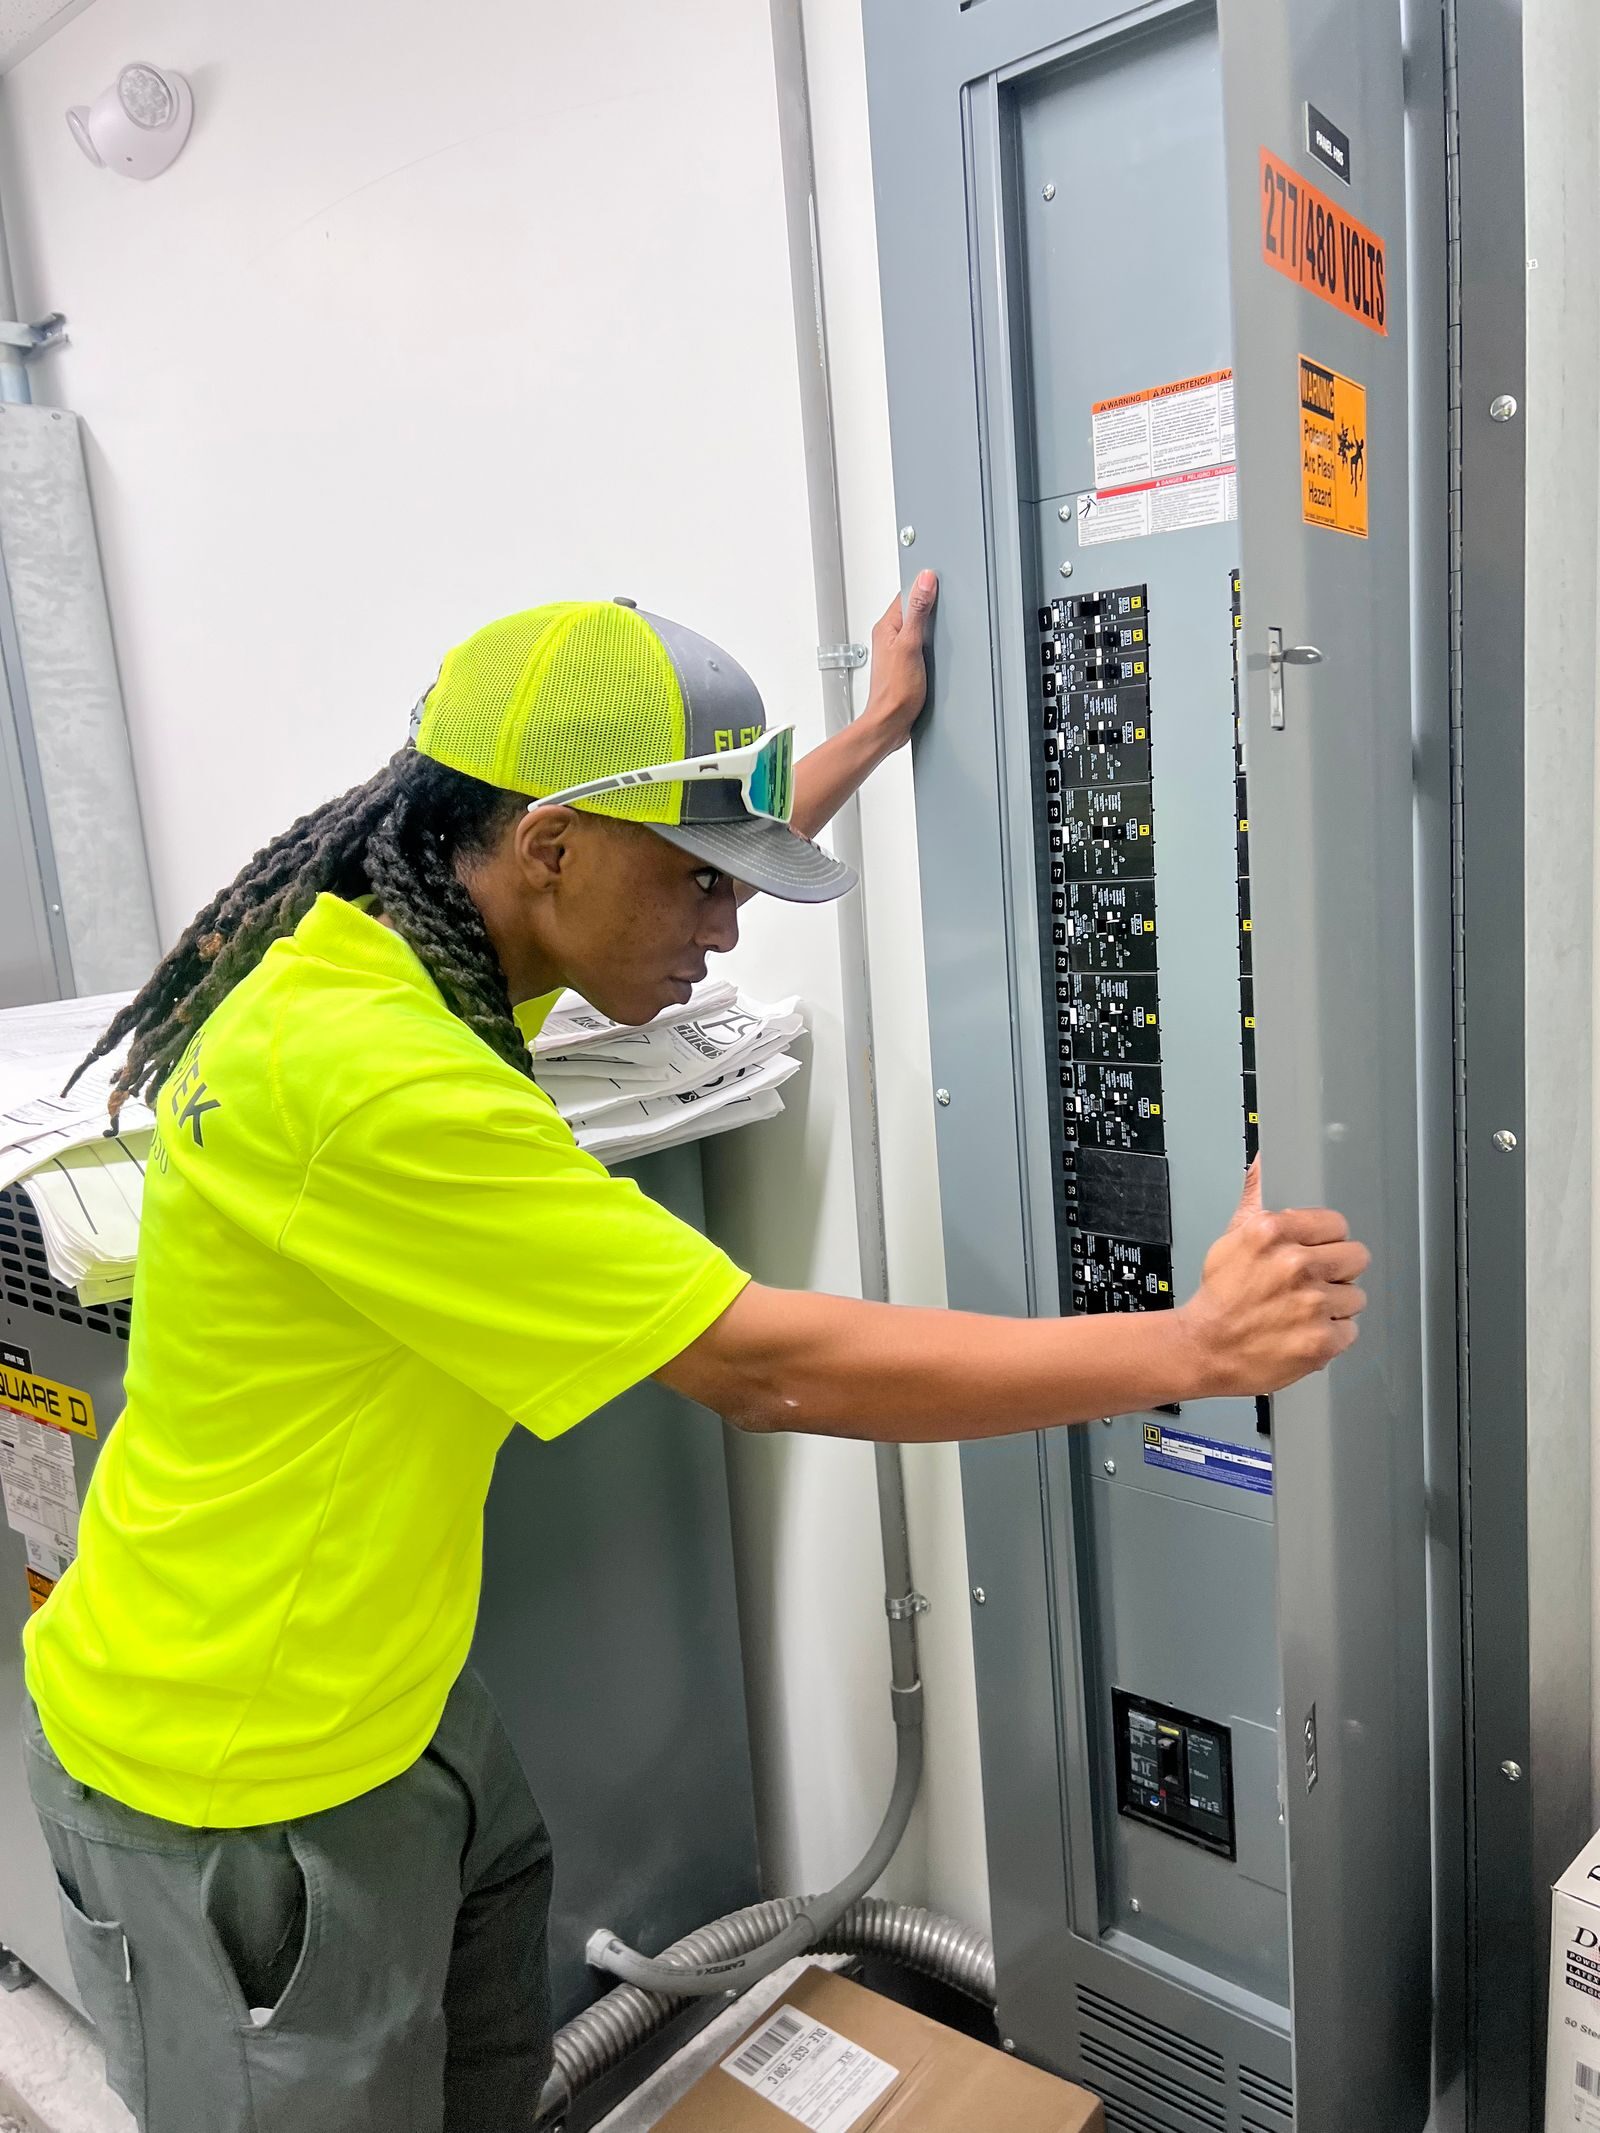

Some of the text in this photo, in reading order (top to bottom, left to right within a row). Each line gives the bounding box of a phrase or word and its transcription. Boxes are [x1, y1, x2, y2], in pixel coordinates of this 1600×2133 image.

[1265, 164, 1384, 326] 277/480 VOLTS
[1160, 376, 1213, 396] ADVERTENCIA
[1301, 366, 1334, 414] WARNING
[1107, 394, 1141, 409] WARNING
[1303, 419, 1333, 451] Potential
[1303, 449, 1335, 481] Arc Flash
[1308, 480, 1332, 508] Hazard
[68, 1396, 88, 1427] D
[1569, 1966, 1599, 1984] LATEX
[1564, 2016, 1577, 2028] 50
